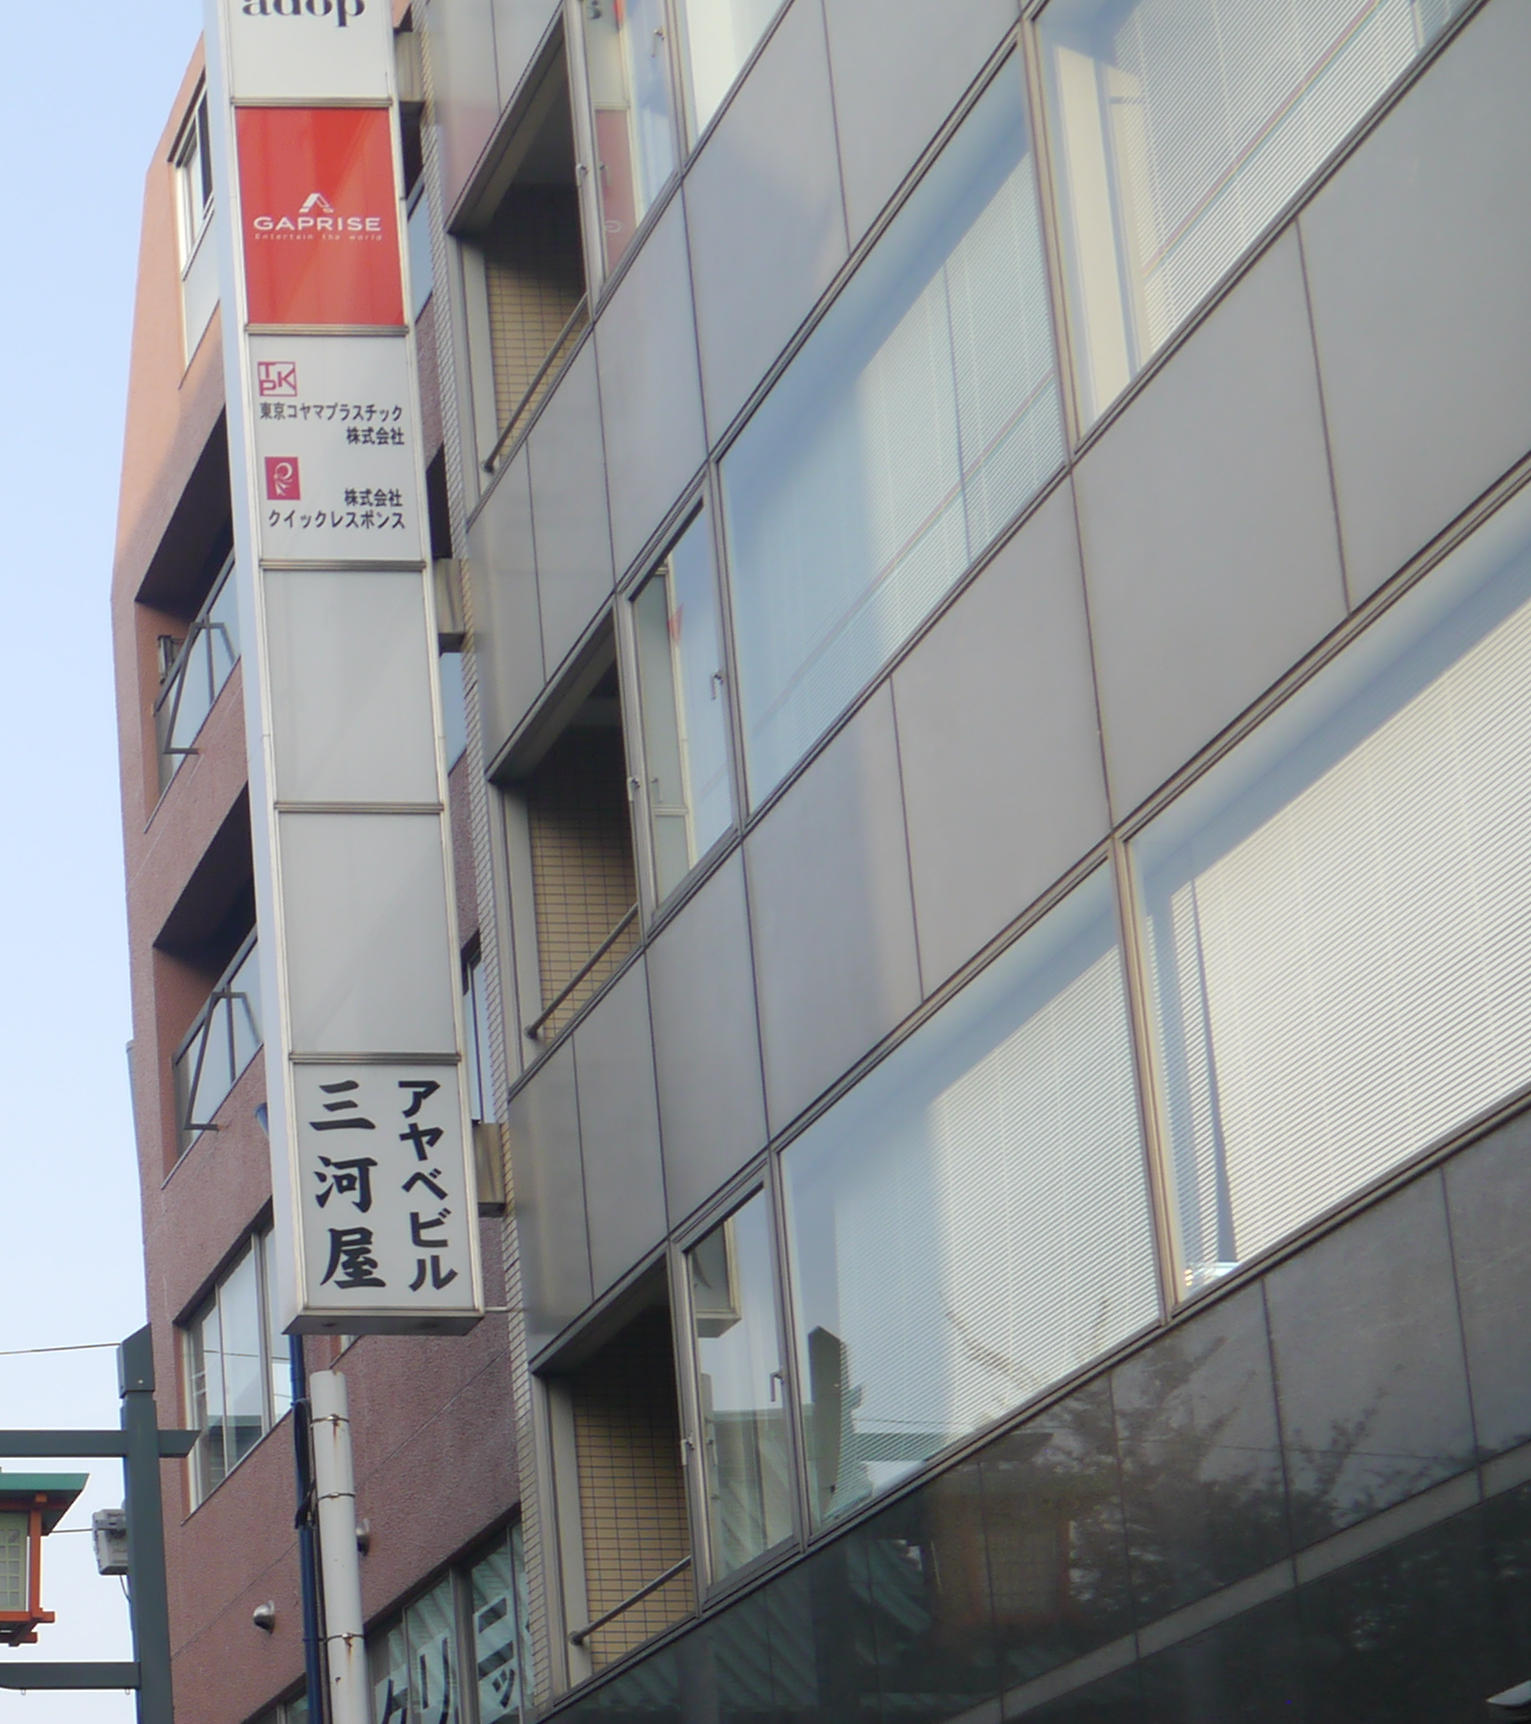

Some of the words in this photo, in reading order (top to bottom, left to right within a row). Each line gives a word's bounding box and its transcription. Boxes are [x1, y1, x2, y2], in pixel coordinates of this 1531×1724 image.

[253, 216, 381, 231] GAPRISE
[260, 402, 403, 422] 東京コヤマプラスチック
[346, 426, 405, 445] 株式会社
[344, 488, 403, 507] 株式会社
[268, 509, 405, 529] クイックレスポンス
[309, 1080, 386, 1289] 三河屋
[398, 1080, 459, 1292] アヤベビル
